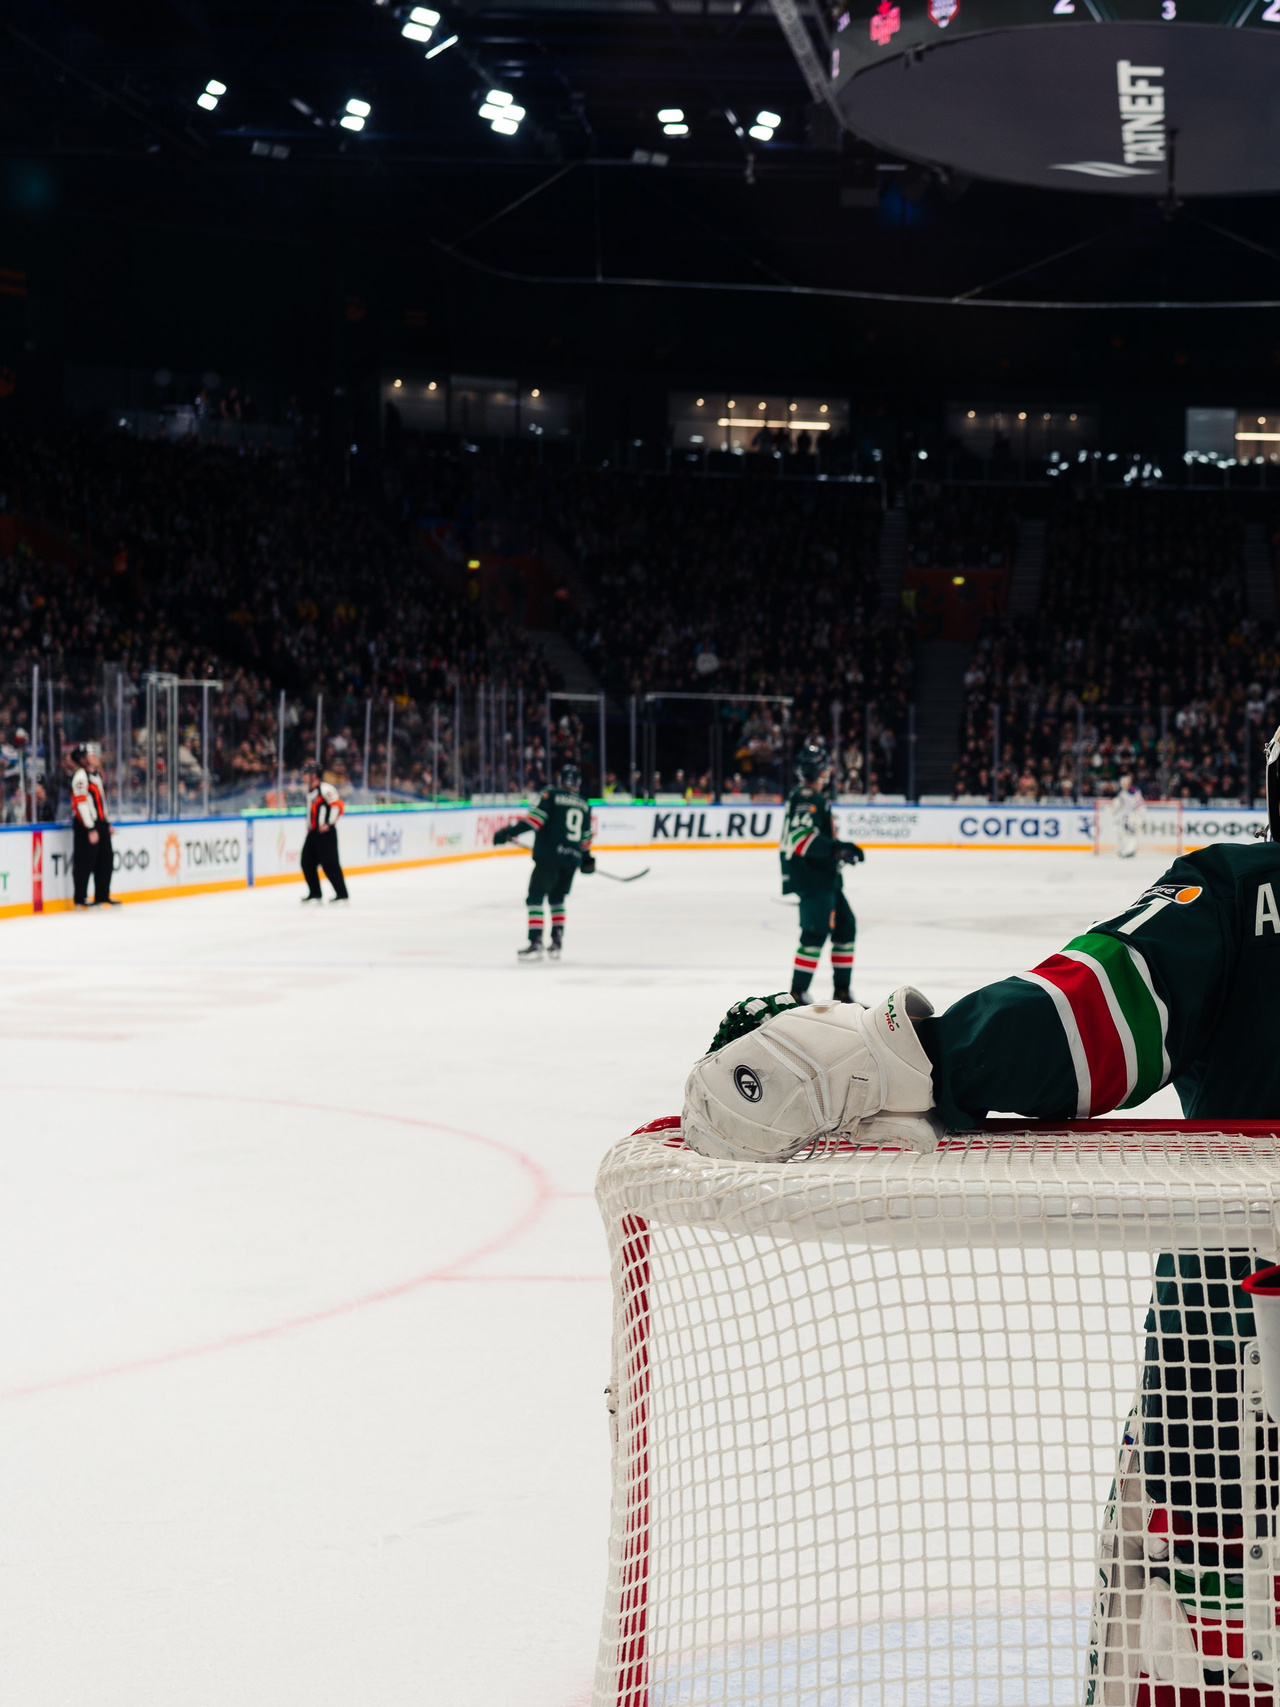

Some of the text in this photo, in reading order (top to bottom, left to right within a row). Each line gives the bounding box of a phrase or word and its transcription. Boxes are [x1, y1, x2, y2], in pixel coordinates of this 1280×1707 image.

[1161, 0, 1176, 20] 3
[1117, 60, 1166, 163] TATNEFT
[565, 807, 584, 843] 9
[652, 813, 772, 838] KHL.RU
[846, 813, 919, 826] САДОВОЕ
[368, 821, 403, 857] Haier
[847, 827, 912, 840] КОЛЬЦО
[885, 1012, 895, 1031] PRO
